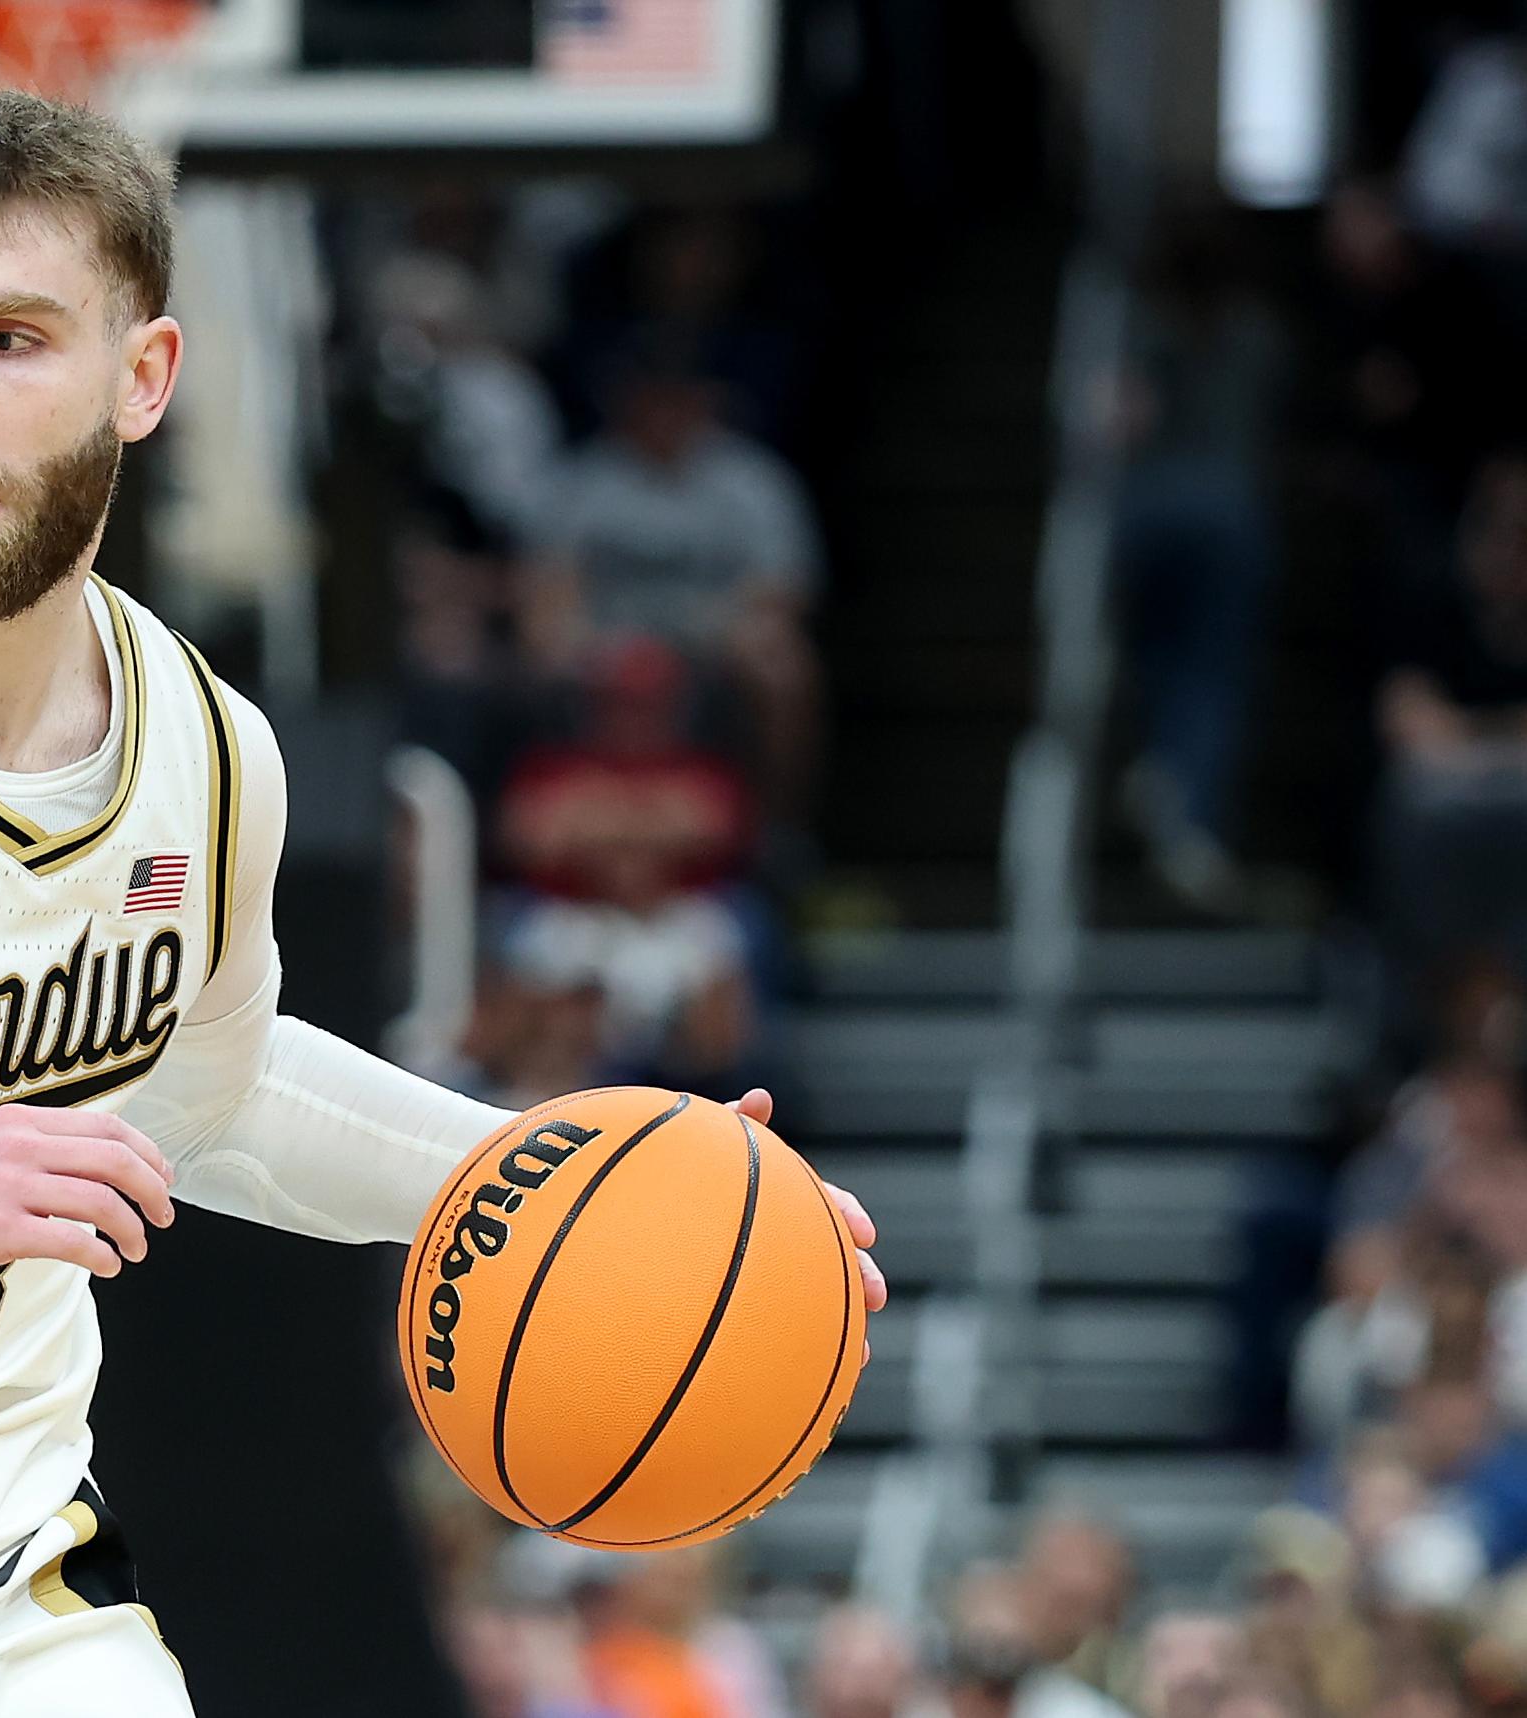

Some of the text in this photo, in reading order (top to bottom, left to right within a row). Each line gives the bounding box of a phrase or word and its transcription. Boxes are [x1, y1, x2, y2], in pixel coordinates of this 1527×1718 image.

[425, 1119, 604, 1393] Wilson
[426, 1190, 470, 1279] EVO NXT
